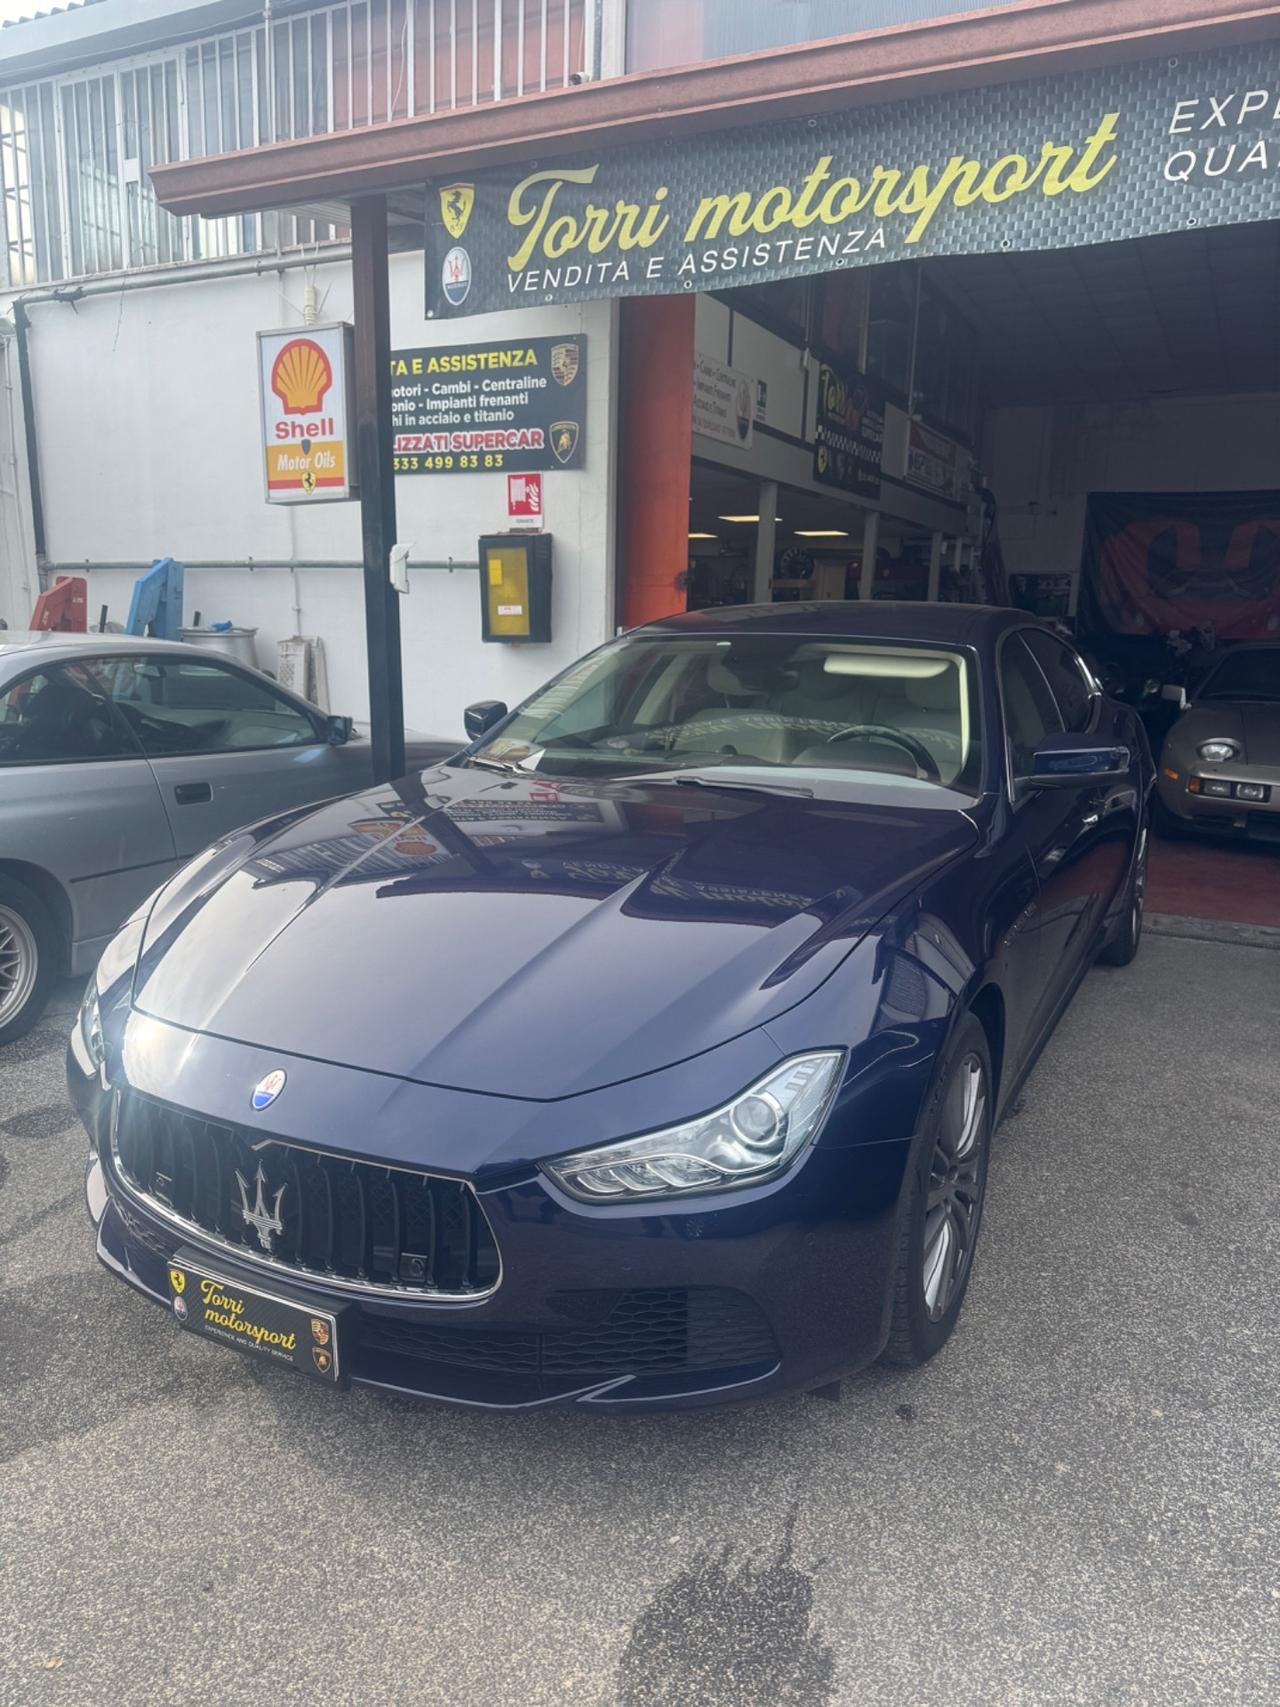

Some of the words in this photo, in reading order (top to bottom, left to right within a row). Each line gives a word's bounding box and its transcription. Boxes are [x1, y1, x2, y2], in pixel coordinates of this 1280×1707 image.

[1163, 140, 1280, 182] QUA
[507, 163, 670, 273] Torri
[683, 112, 1121, 244] motorsport
[507, 260, 631, 294] VENDITA
[646, 256, 665, 280] E
[677, 227, 885, 276] ASSISTENZA
[412, 358, 424, 375] E
[427, 348, 538, 375] ASSISTENZA
[391, 383, 422, 398] otori
[432, 379, 471, 395] Cambi
[481, 375, 547, 392] Centraline
[426, 394, 477, 411] Impianti
[479, 391, 529, 407] frenanti
[275, 417, 335, 440] Shell
[405, 413, 416, 426] in
[418, 411, 461, 426] acciaio
[464, 412, 472, 423] e
[474, 408, 514, 423] titanio
[392, 432, 450, 453] IZZATI
[451, 429, 544, 452] SUPERCAR
[277, 453, 312, 471] Motor
[314, 450, 336, 469] Oils
[393, 456, 419, 470] 333
[424, 455, 453, 469] 499
[460, 454, 478, 469] 83
[484, 453, 503, 468] 83
[200, 1279, 245, 1314] Torri
[204, 1309, 296, 1350] motorsport
